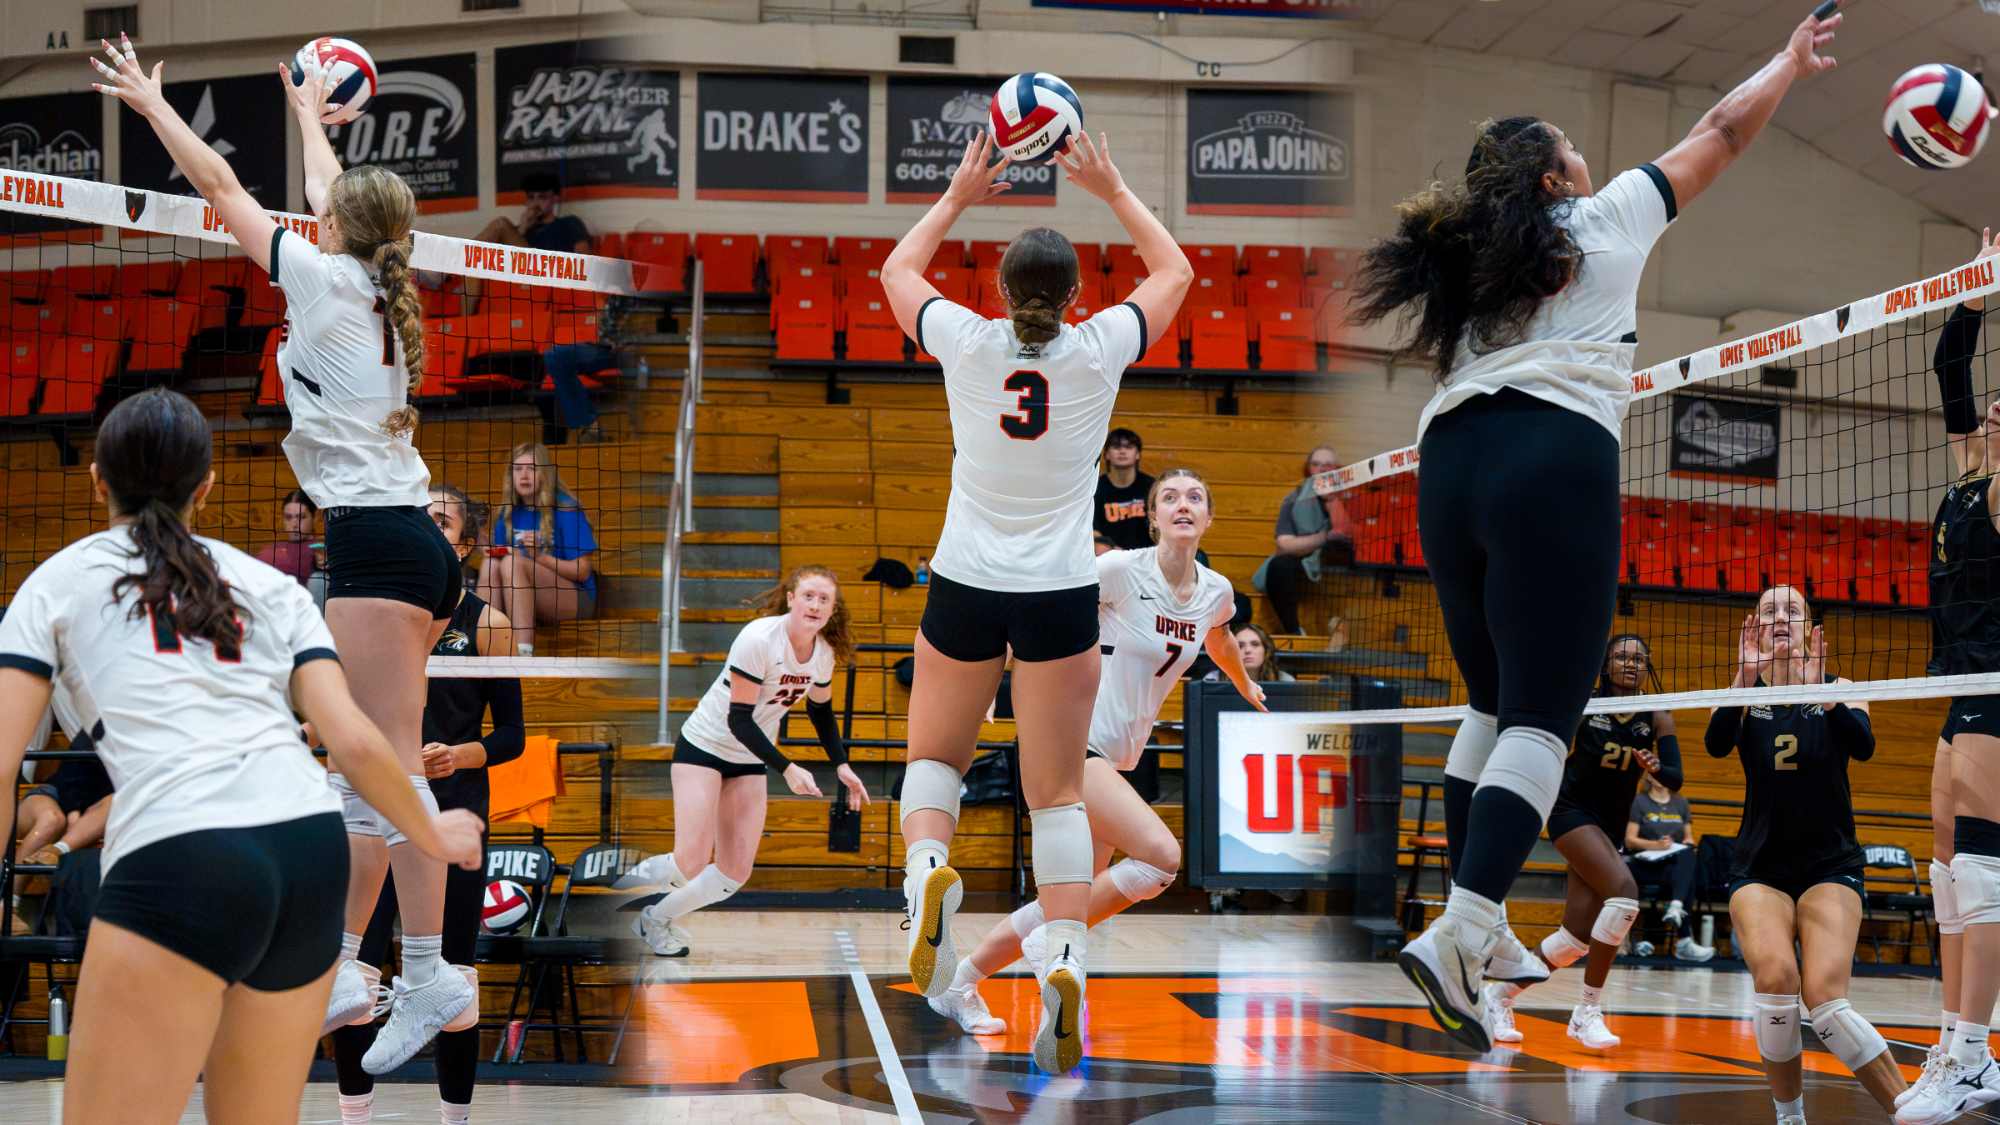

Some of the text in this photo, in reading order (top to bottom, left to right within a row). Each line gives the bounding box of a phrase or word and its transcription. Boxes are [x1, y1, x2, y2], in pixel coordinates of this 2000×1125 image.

[503, 103, 637, 140] RAYNE
[1255, 113, 1287, 125] PIZZA
[1014, 130, 1050, 156] Baden
[1200, 135, 1343, 172] PAPA JOHN'S
[0, 175, 65, 208] EYBALL
[464, 244, 588, 282] UPIKE VOLLEYBALL
[1885, 260, 1995, 315] UPIKE VOLLEYBALL
[1719, 324, 1803, 369] UPIKE VOLLEYBALL
[999, 369, 1050, 441] 3
[1104, 502, 1146, 523] UPIKE
[1155, 614, 1197, 643] UPIKE
[1154, 641, 1183, 678] 7
[765, 688, 806, 708] 25
[1600, 741, 1633, 771] 21
[1774, 734, 1798, 771] 2
[487, 850, 541, 880] PIKE
[583, 849, 651, 880] UPIKE
[1865, 846, 1907, 866] UPIKE
